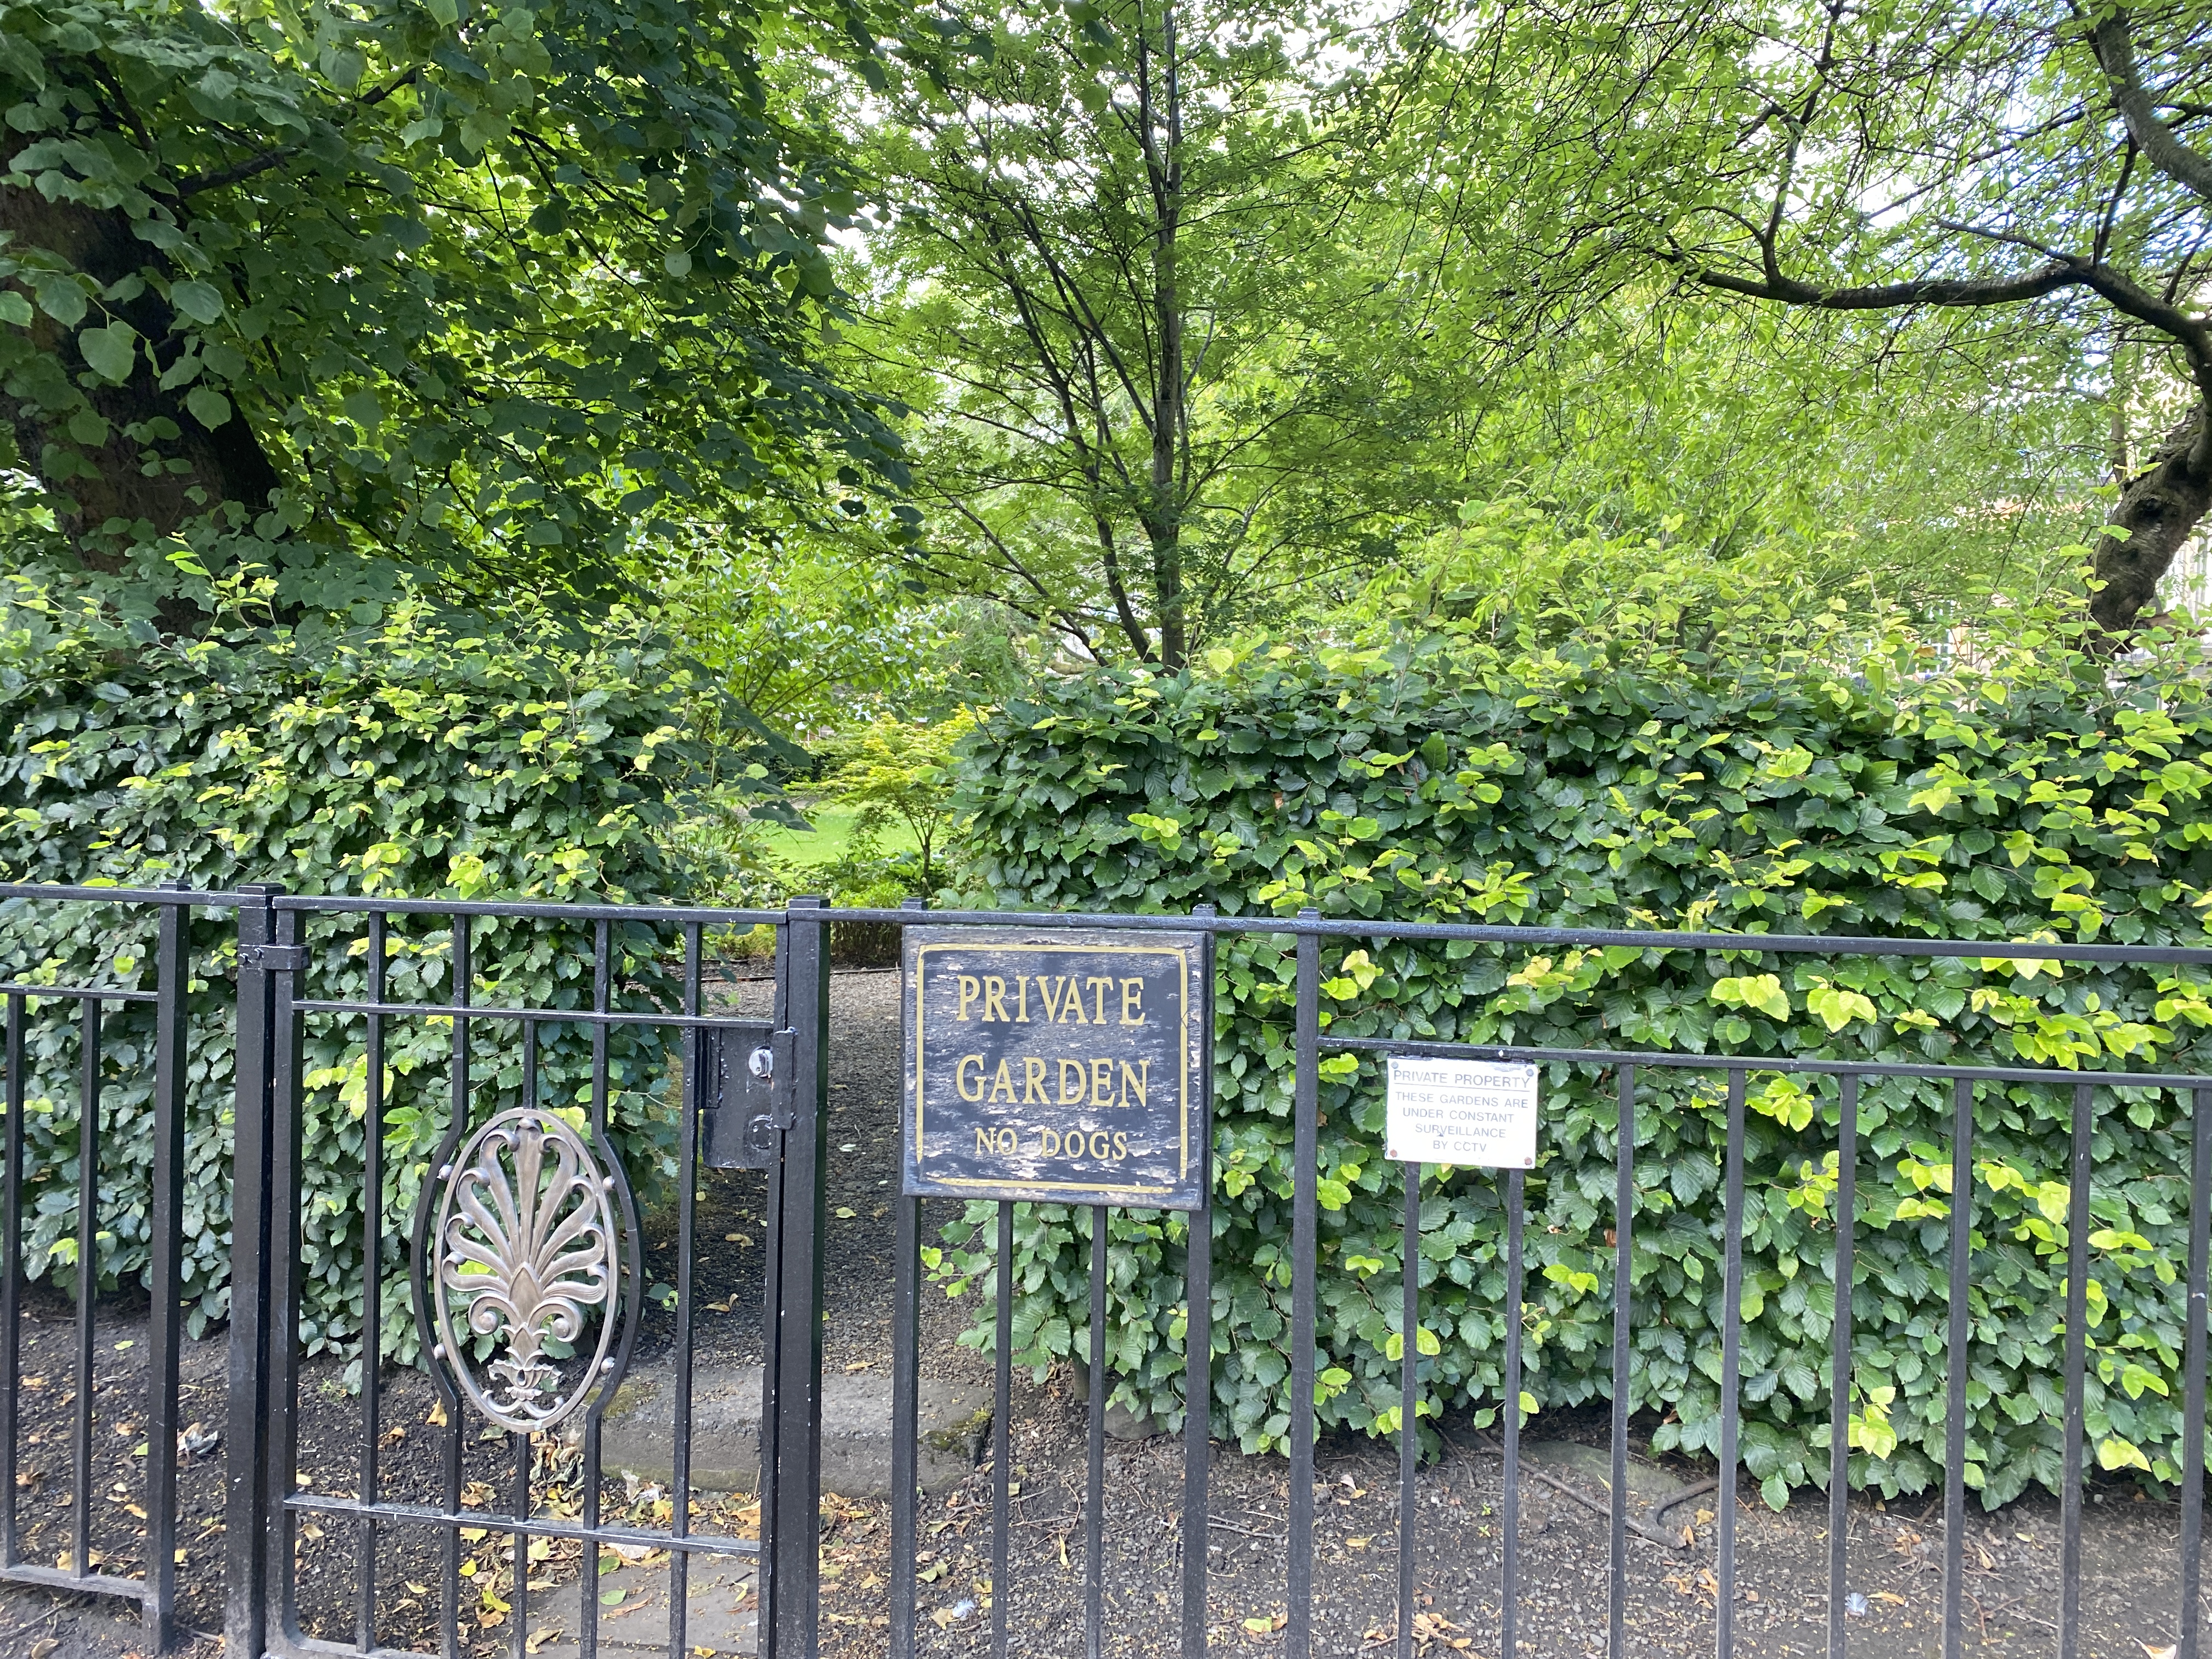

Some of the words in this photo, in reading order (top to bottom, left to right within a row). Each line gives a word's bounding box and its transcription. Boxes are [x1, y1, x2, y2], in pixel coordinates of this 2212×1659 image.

[956, 974, 1146, 1026] PRIVATE
[956, 1054, 1150, 1107] GARDEN
[1393, 1070, 1448, 1084] PRIVATE
[1454, 1074, 1530, 1088] PROPERTY
[1395, 1091, 1434, 1103] THESE
[1440, 1094, 1498, 1107] GARDENS
[1504, 1098, 1528, 1108] ARE
[1403, 1107, 1443, 1119] UNDER
[1449, 1110, 1514, 1123] CONSTANT
[1415, 1124, 1506, 1138] SURVEILLANCE
[975, 1127, 1018, 1155] NO
[1041, 1129, 1128, 1161] DOGS
[1433, 1140, 1448, 1150] BY
[1454, 1141, 1487, 1152] CCTV
